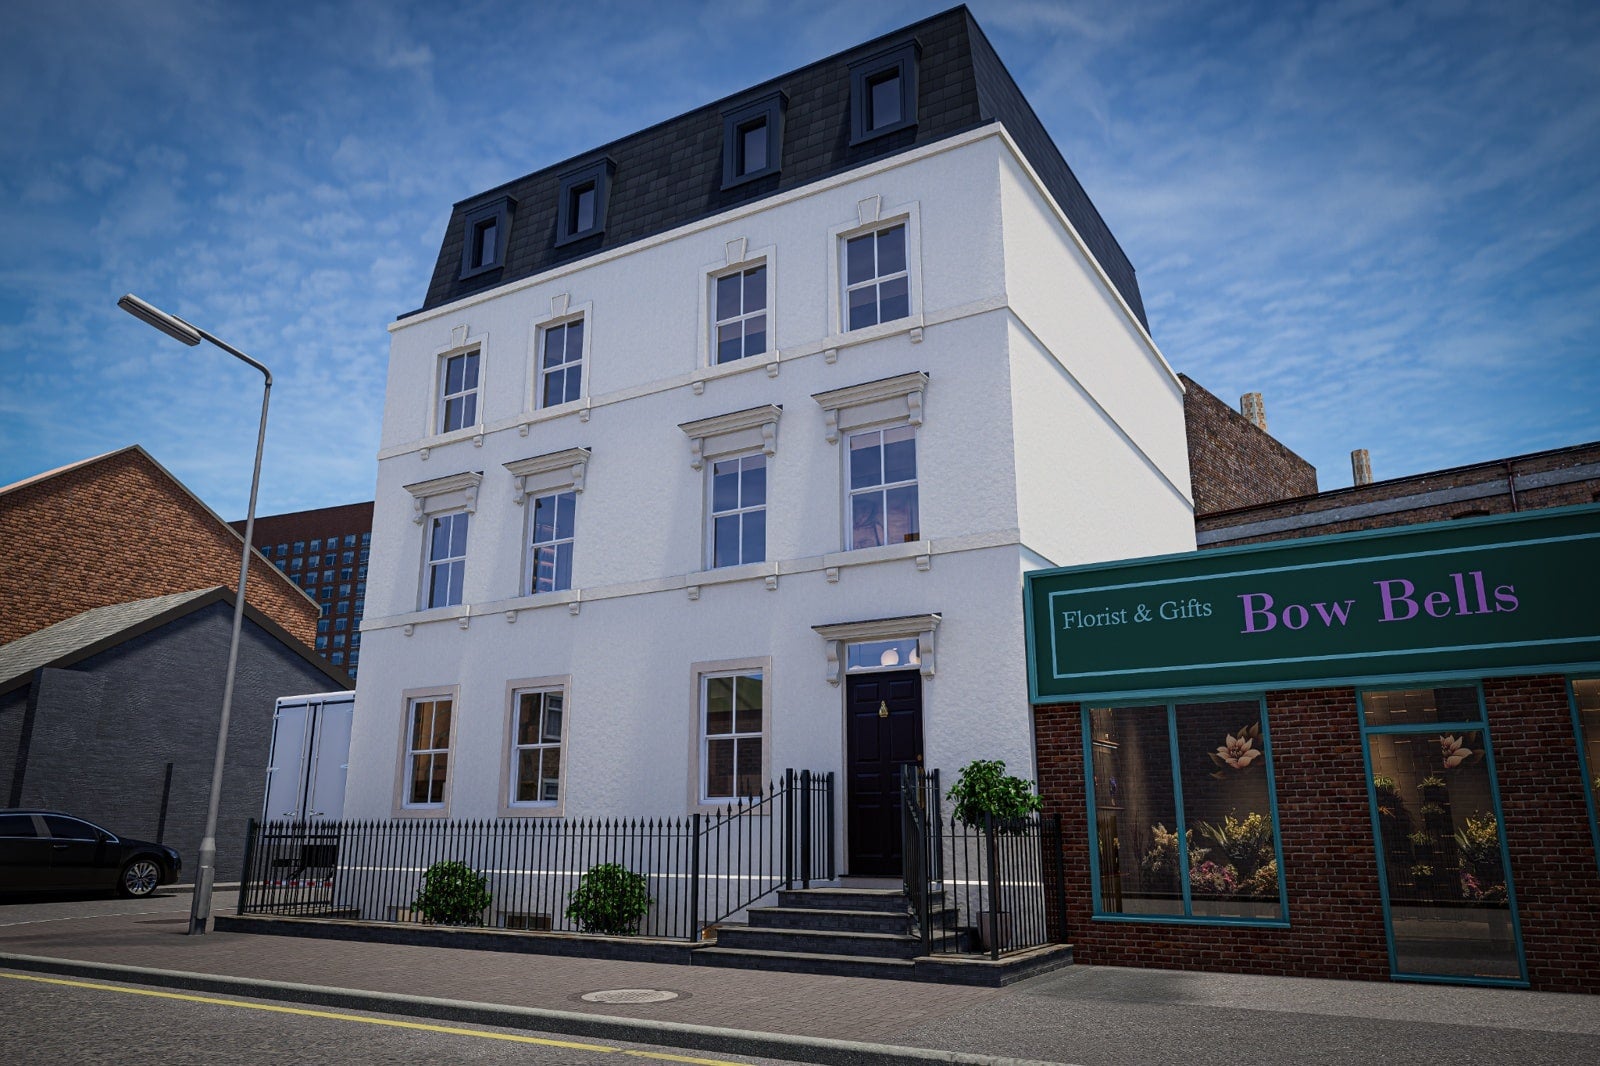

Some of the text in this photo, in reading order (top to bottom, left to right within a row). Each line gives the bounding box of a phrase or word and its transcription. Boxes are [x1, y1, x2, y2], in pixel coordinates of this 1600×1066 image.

[1062, 598, 1213, 630] Florist & Gifts
[1237, 570, 1519, 634] Bow Bells
